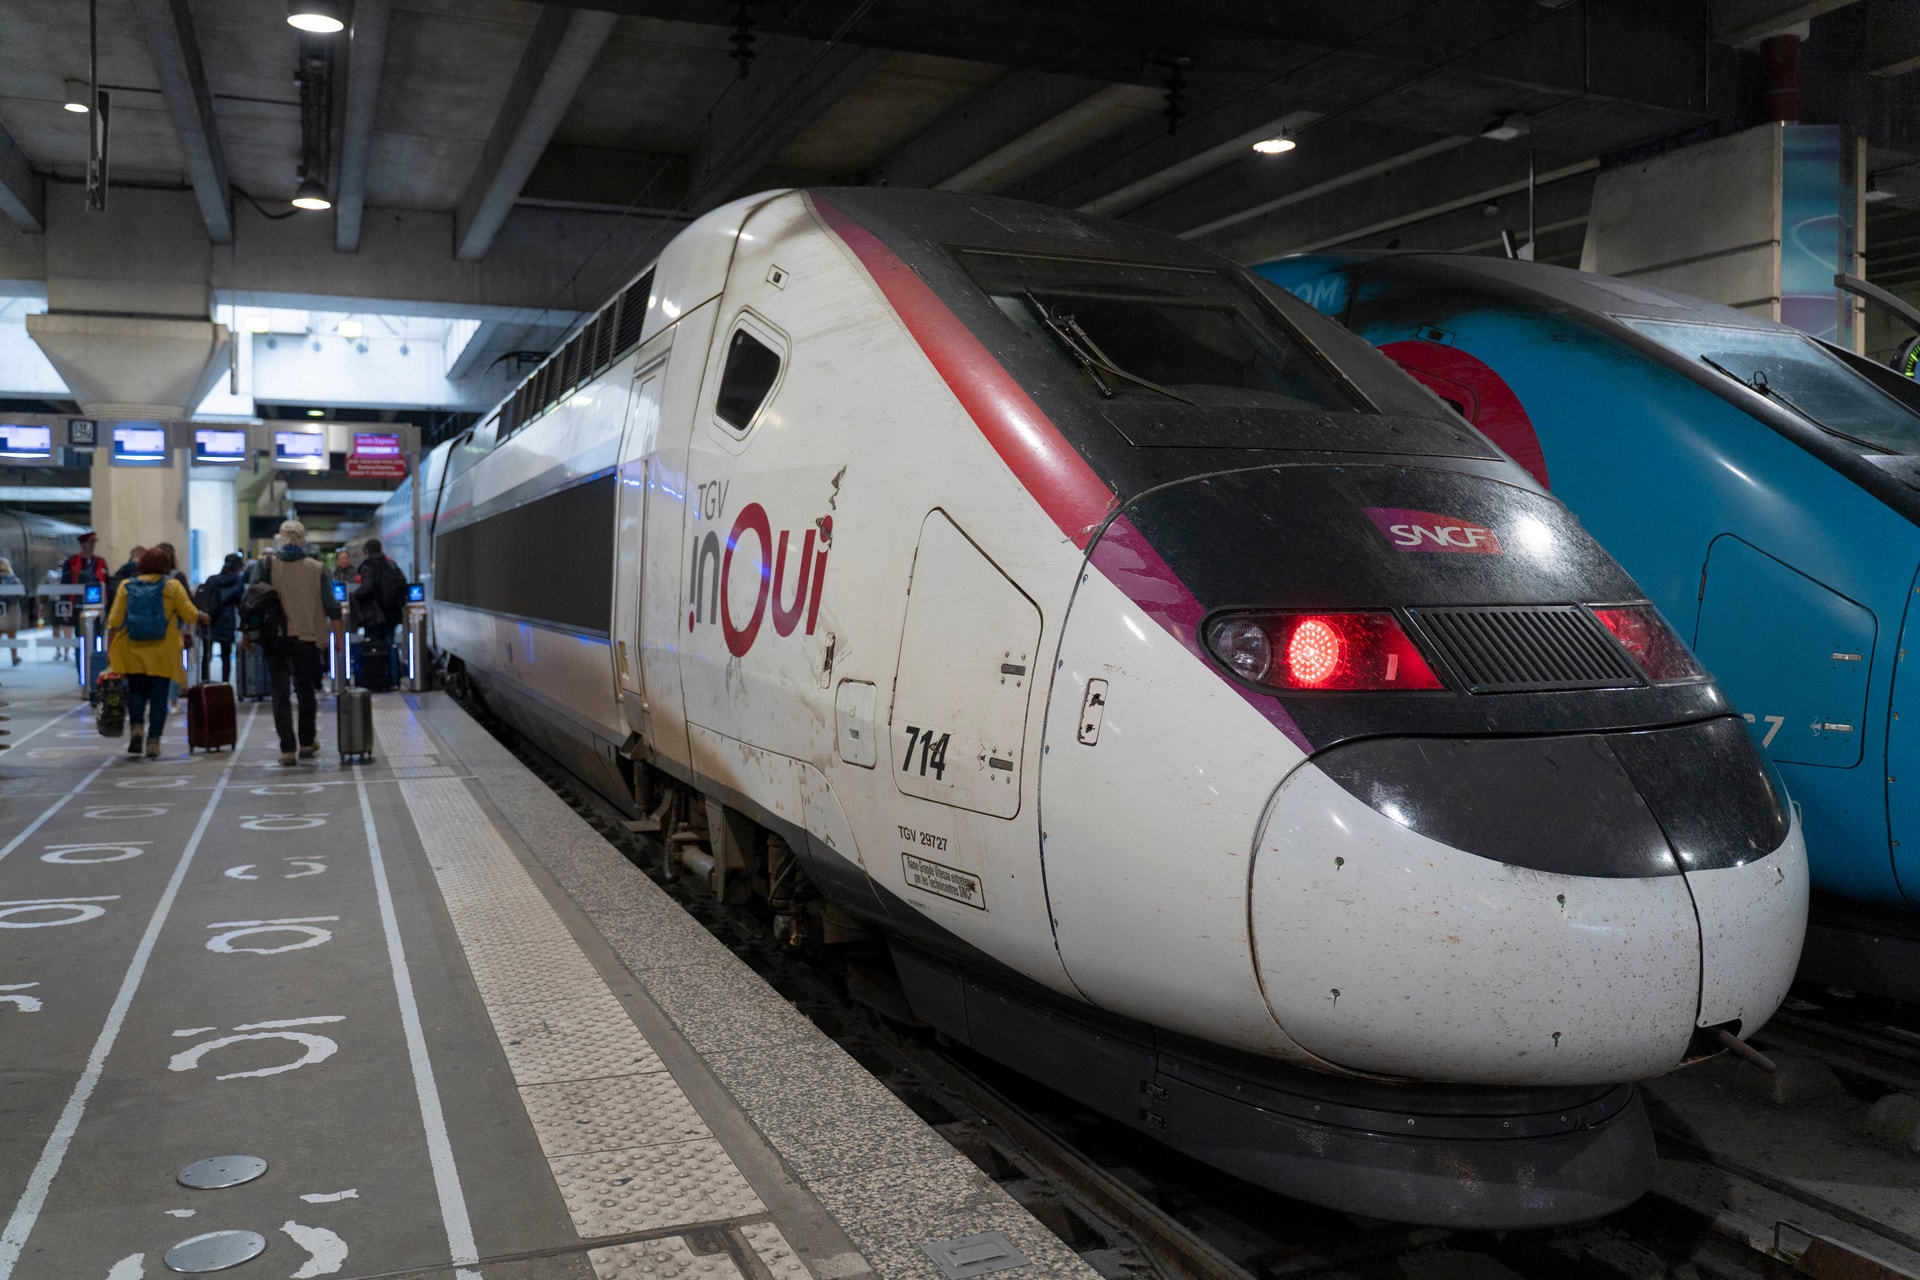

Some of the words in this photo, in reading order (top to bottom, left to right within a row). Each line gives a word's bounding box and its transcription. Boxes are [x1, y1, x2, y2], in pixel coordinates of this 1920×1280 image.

[1284, 276, 1341, 308] OM
[697, 480, 730, 521] TGV
[1389, 524, 1487, 548] SNCF
[902, 725, 951, 781] 714
[897, 825, 916, 842] TGV
[920, 831, 947, 851] 29727
[919, 860, 934, 876] Grande
[920, 872, 929, 887] les
